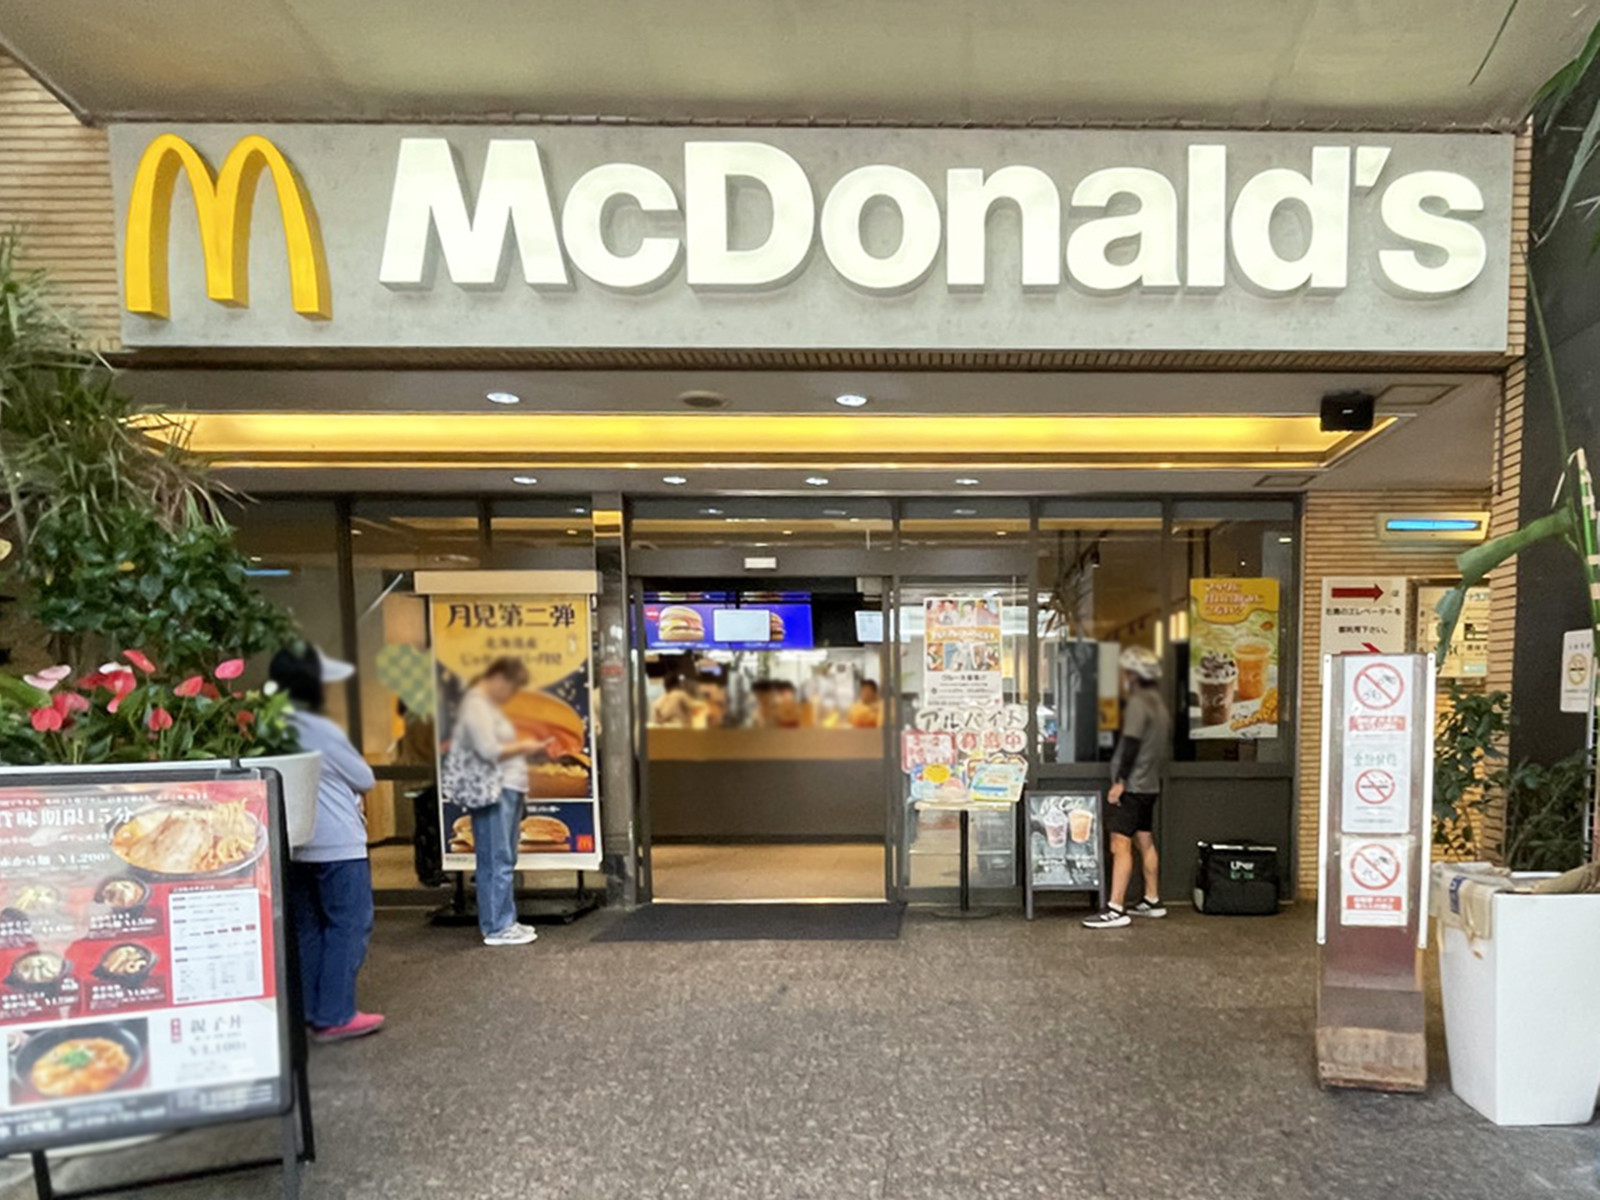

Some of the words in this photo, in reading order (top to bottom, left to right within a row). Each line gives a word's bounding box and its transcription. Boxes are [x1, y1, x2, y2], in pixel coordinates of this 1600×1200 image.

[379, 137, 1487, 295] McDonald's
[447, 602, 575, 628] 月見第二弾
[920, 705, 1021, 731] アルバイト
